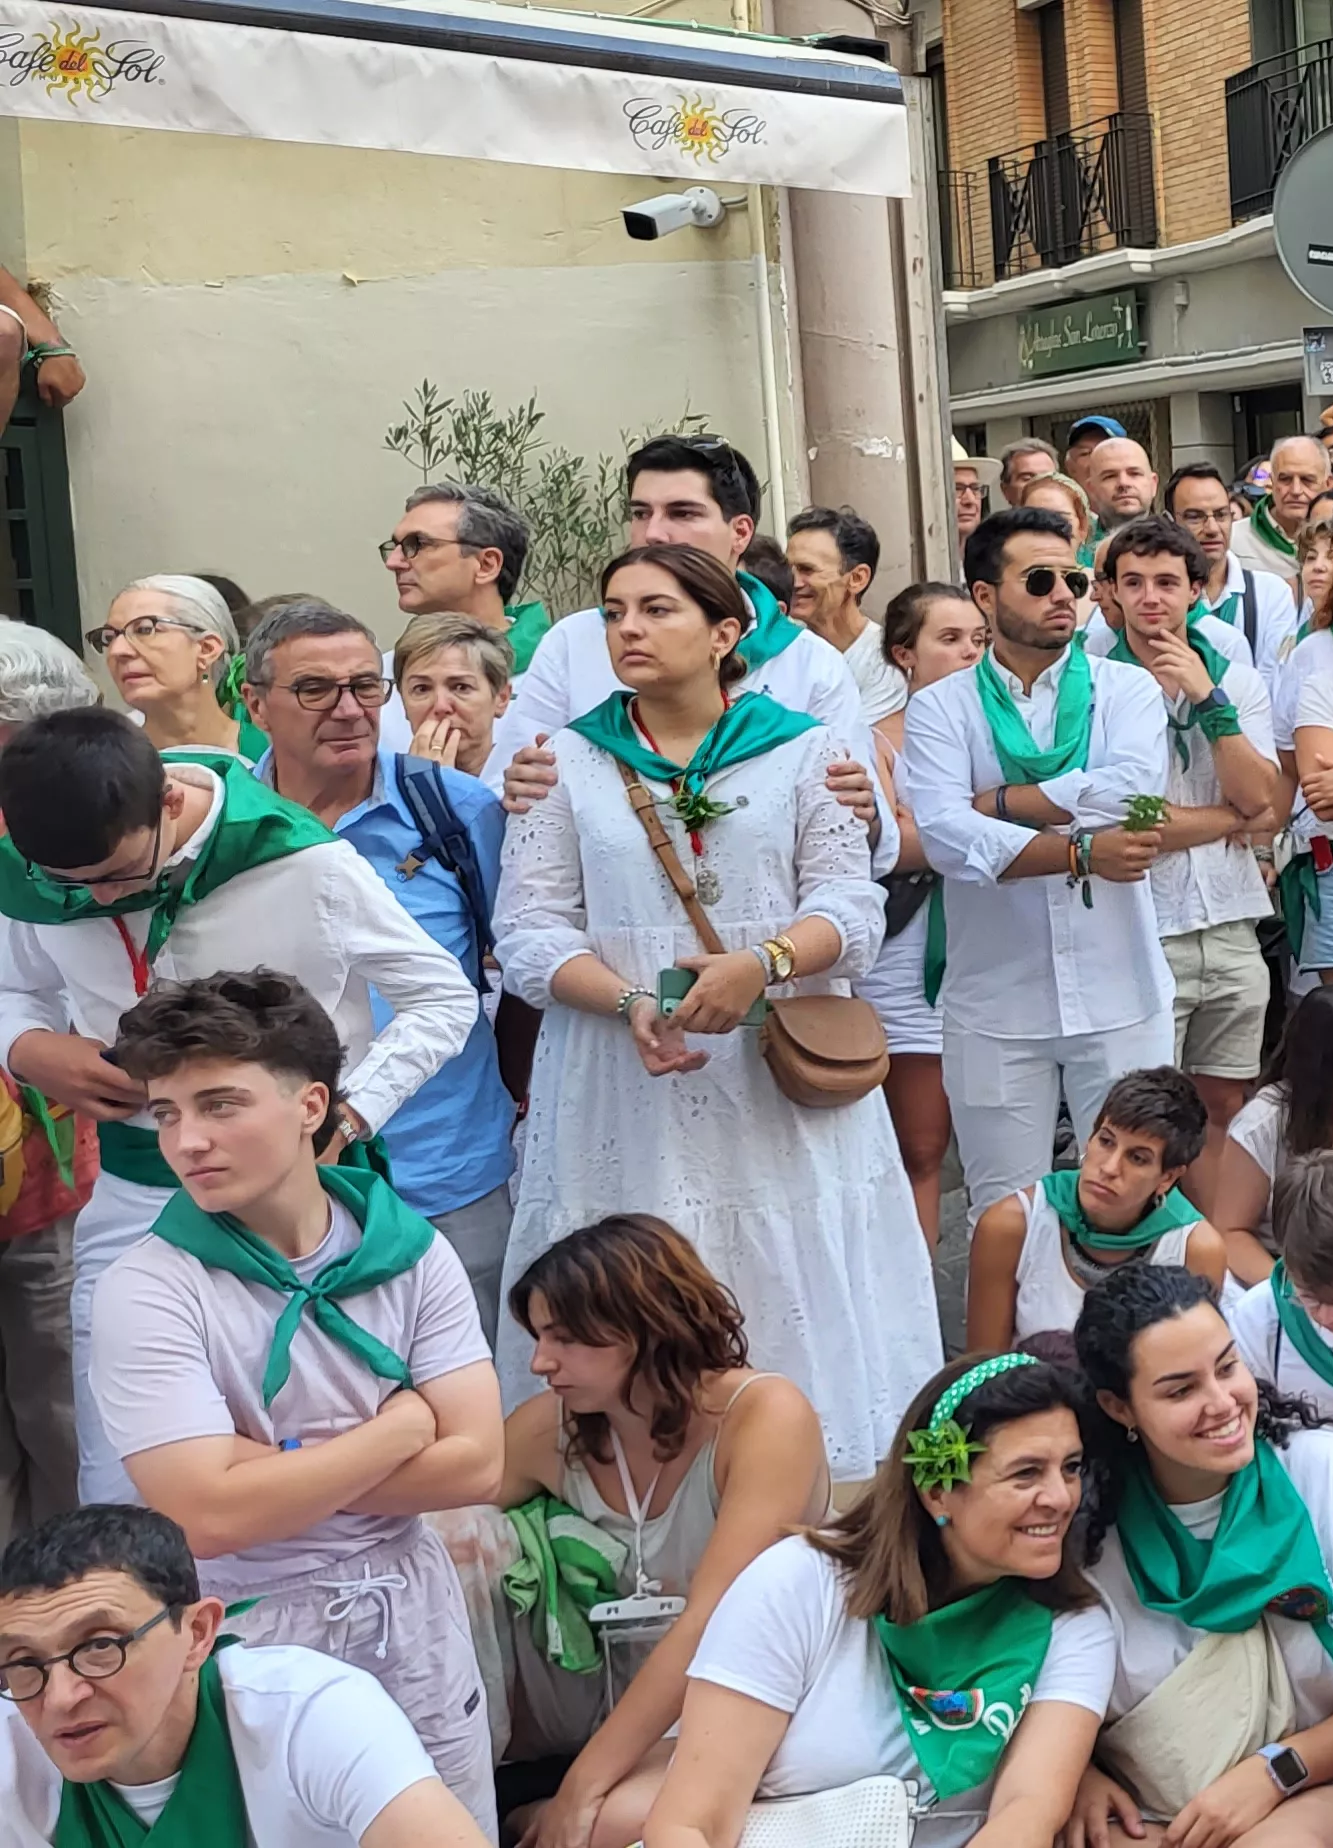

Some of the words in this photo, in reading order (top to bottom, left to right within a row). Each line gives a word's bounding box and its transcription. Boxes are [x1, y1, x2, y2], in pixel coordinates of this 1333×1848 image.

[58, 50, 88, 73] del
[92, 39, 165, 97] Sol
[687, 118, 710, 137] del
[711, 108, 767, 157] Sol
